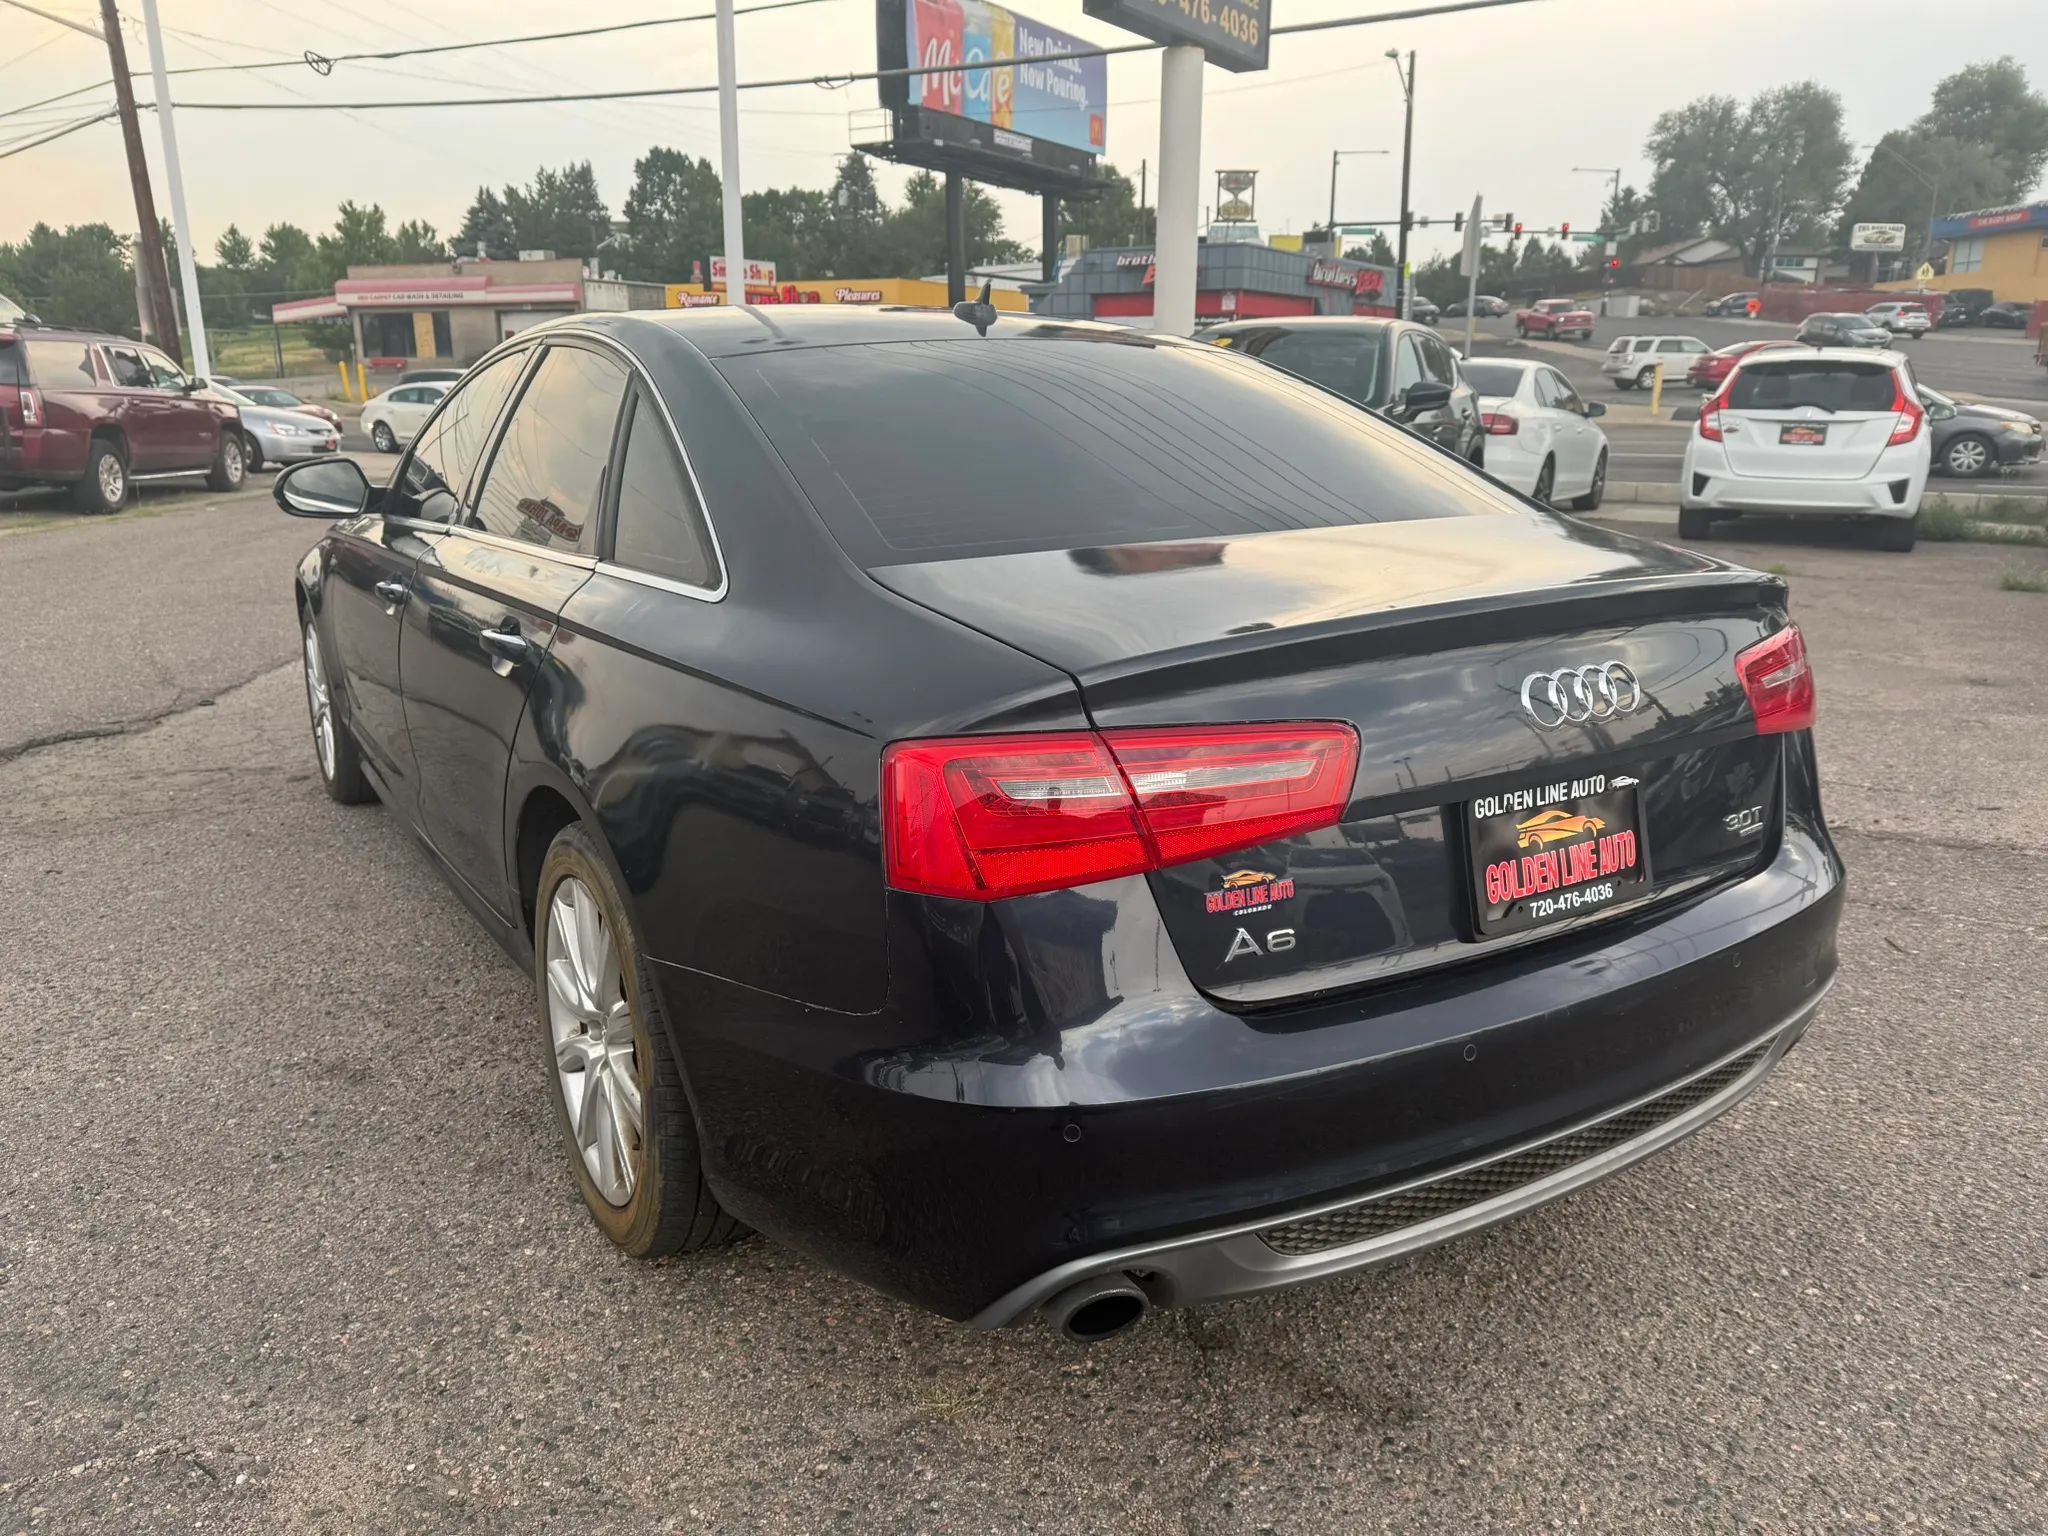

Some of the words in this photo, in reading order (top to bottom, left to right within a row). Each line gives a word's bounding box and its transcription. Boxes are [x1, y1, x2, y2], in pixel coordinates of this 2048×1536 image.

[1019, 27, 1044, 54] New
[1020, 62, 1044, 92] Now
[1046, 70, 1089, 111] Pouring.
[677, 291, 719, 307] Romance
[834, 287, 881, 303] Pleasures
[1474, 788, 1534, 819] GOLDEN
[1536, 781, 1568, 811] LINE
[1570, 774, 1606, 800] AUTO
[1485, 849, 1560, 905] GOLDEN
[1559, 839, 1599, 888] LINE
[1599, 829, 1637, 876] AUTO
[1205, 888, 1247, 914] GOLDEN
[1246, 883, 1270, 907] LINE
[1269, 879, 1296, 902] AUTO
[1232, 903, 1273, 917] COLORADO
[1529, 882, 1614, 919] 720-476-4036
[1223, 926, 1297, 963] A6
